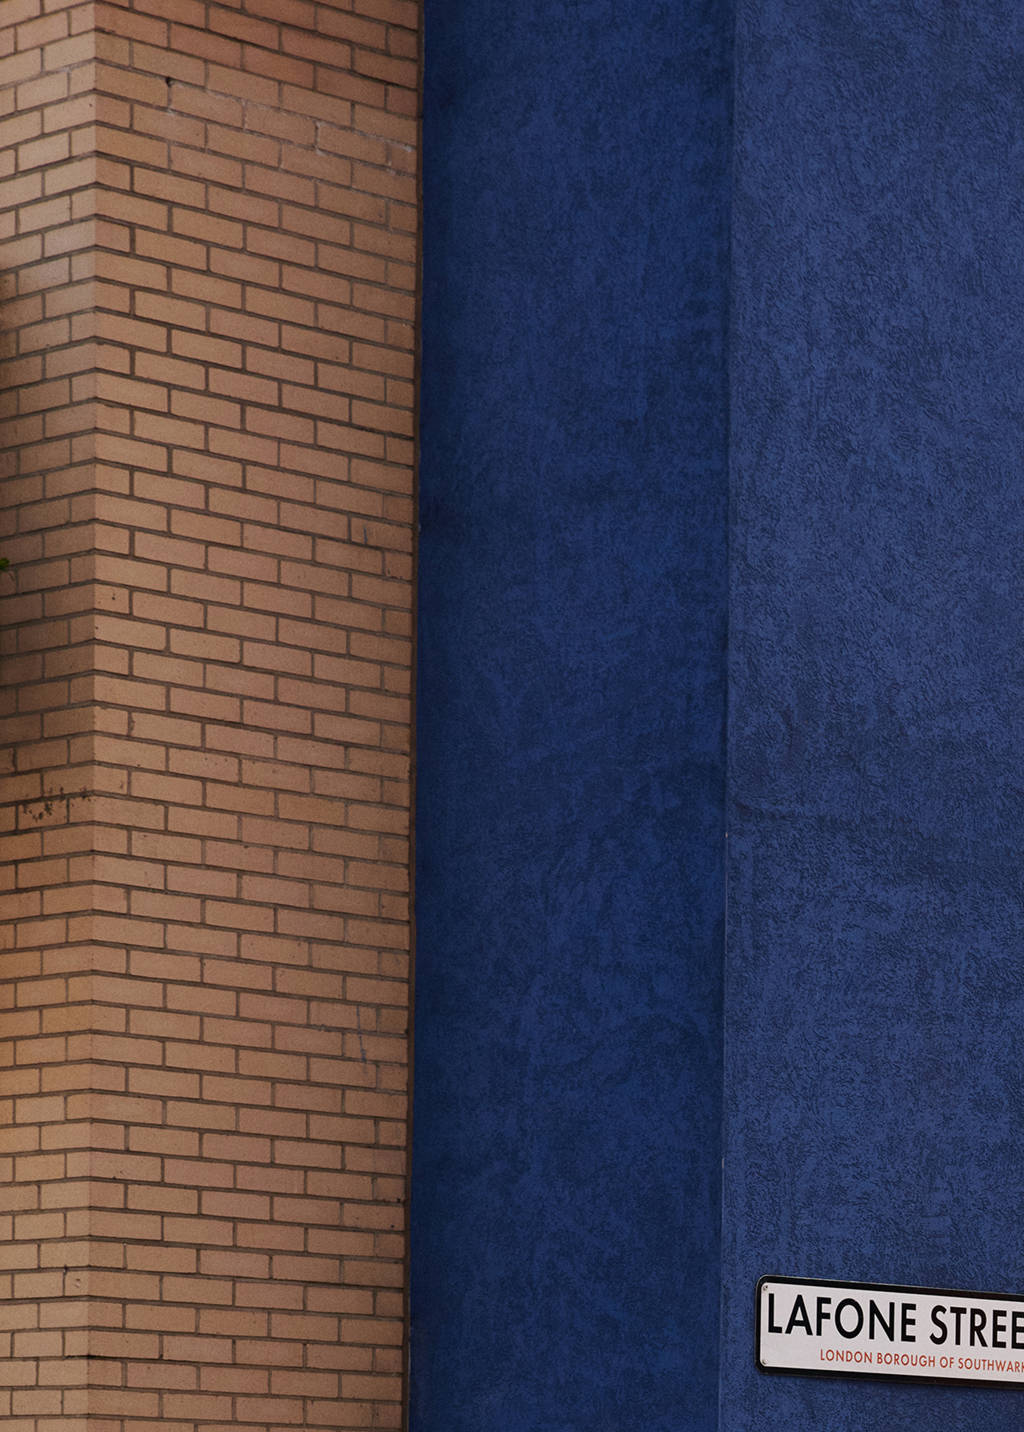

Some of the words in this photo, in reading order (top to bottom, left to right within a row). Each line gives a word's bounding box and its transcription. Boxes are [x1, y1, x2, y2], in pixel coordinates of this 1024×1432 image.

[767, 1292, 917, 1343] LAFONE
[820, 1349, 873, 1364] LONDON
[876, 1352, 936, 1369] BOROUGH
[939, 1356, 955, 1369] OF
